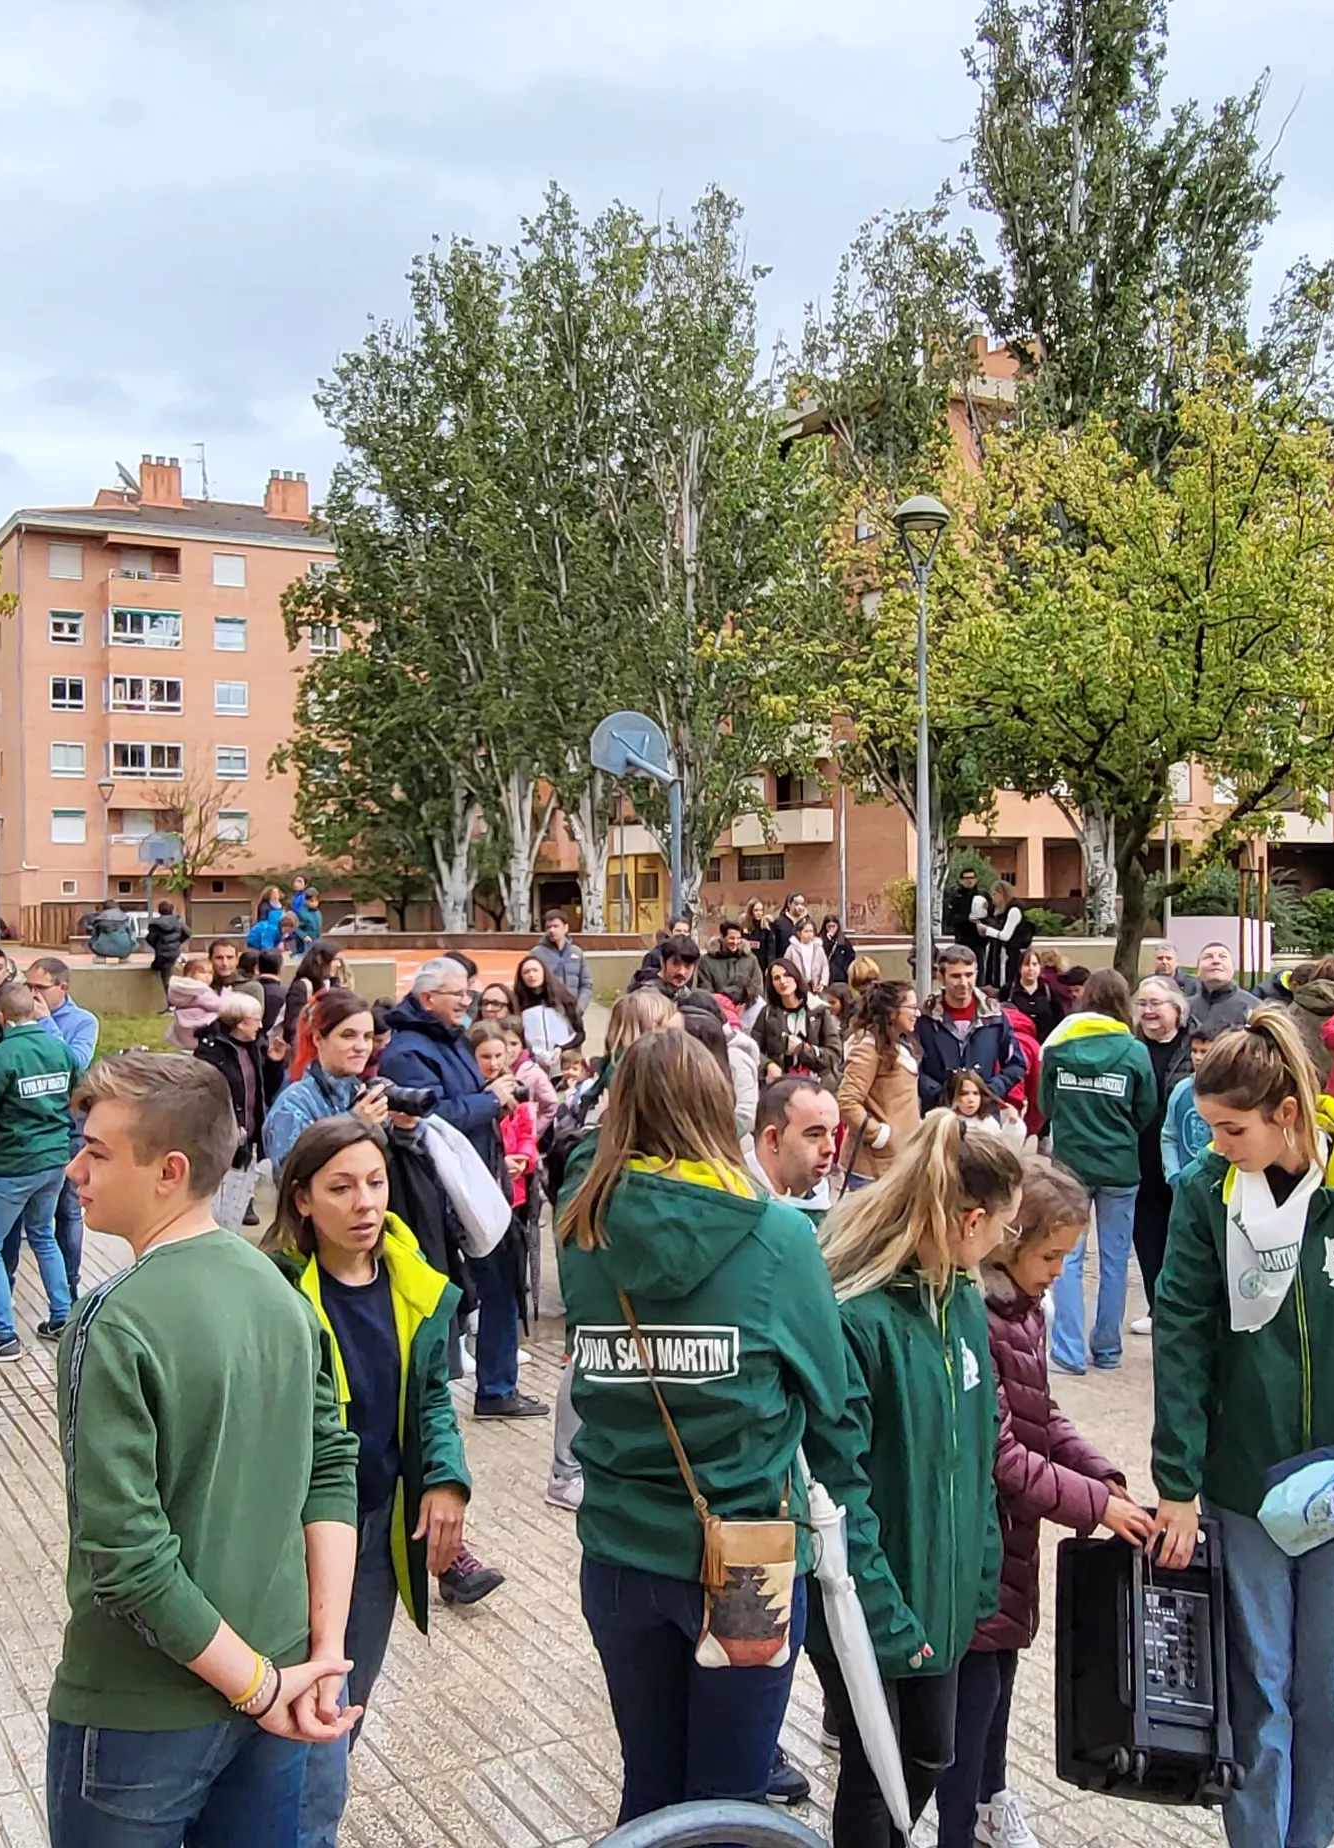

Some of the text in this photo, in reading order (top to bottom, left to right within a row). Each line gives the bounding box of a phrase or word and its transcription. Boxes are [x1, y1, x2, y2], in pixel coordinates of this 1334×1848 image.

[578, 1337, 729, 1371] VIVA SAN MARTIN
